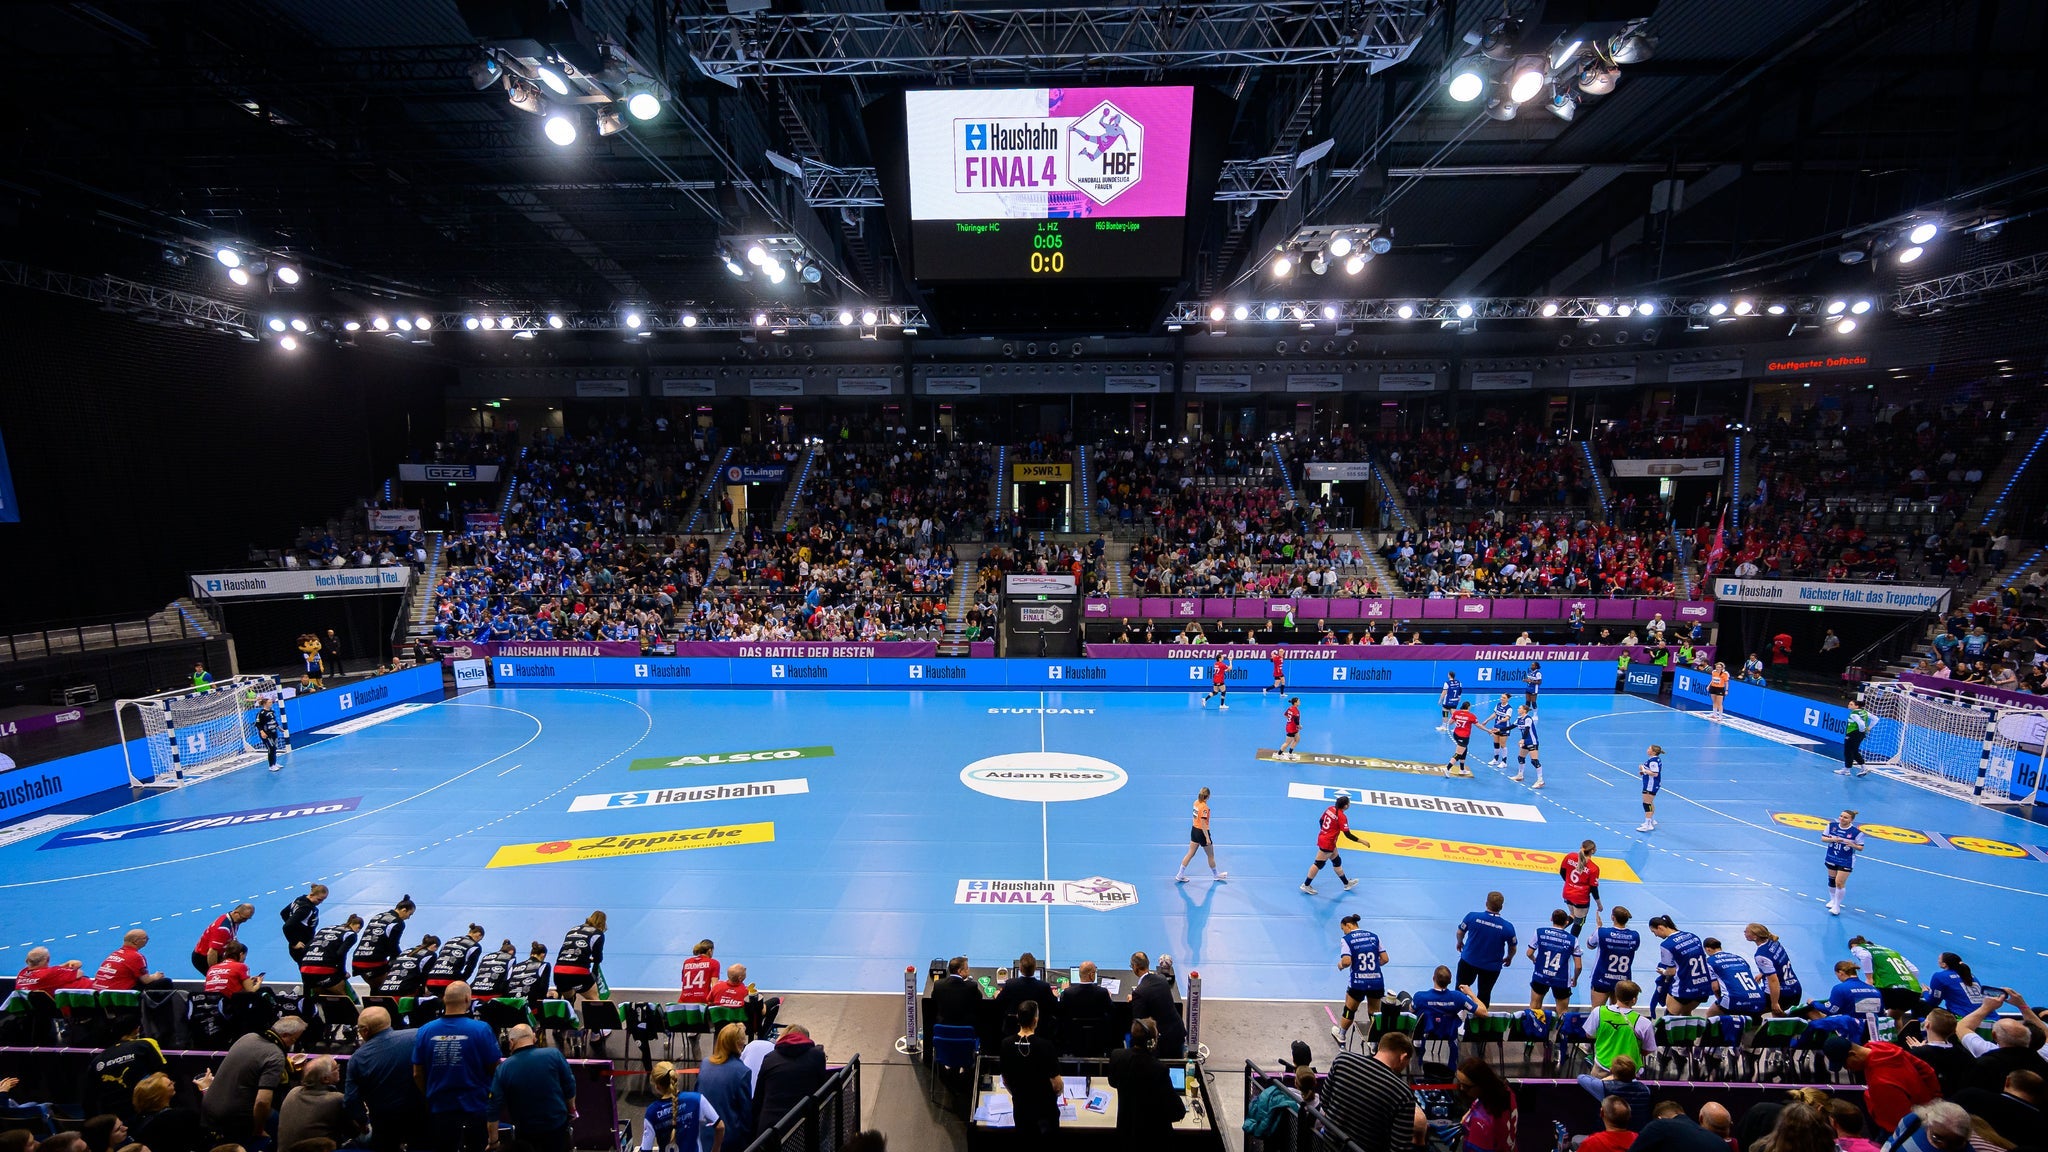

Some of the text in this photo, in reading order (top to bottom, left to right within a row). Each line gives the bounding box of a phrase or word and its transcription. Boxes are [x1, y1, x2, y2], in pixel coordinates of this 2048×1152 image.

[991, 122, 1058, 151] Haushahn
[1102, 152, 1137, 175] HBF
[956, 223, 1000, 234] Thüringer HC
[1037, 222, 1059, 231] 1. HZ
[1033, 234, 1063, 249] 0:05
[1030, 251, 1064, 273] 0:0
[1768, 358, 1824, 371] Stuttgarter
[428, 468, 474, 478] GEZE
[223, 578, 267, 591] Haushahn
[315, 574, 336, 587] Hoch
[337, 573, 364, 586] Hinaus
[364, 574, 381, 585] zum
[1738, 584, 1783, 598] Haushahn
[1800, 586, 1841, 601] Nächster
[1866, 590, 1883, 604] das
[499, 646, 558, 657] HAUSHAHN
[739, 646, 874, 657] DAS BATTLE DER BESTEN
[1475, 650, 1544, 660] HAUSHAHN
[457, 666, 485, 679] hella
[516, 663, 555, 677] Haushahn
[651, 664, 691, 678] Haushahn
[788, 664, 828, 678] Haushahn
[925, 665, 966, 679] Haushahn
[1065, 665, 1106, 680] Haushahn
[1350, 666, 1392, 681] Haushahn
[1627, 672, 1658, 685] hella
[354, 684, 388, 706] Haushahn
[987, 707, 1096, 715] STUTTGART
[0, 721, 18, 738] L4
[664, 749, 801, 768] ALSCO
[985, 771, 1104, 779] Adam Riese
[0, 773, 63, 809] aushahn
[655, 782, 776, 804] Haushahn
[1371, 791, 1504, 817] Haushahn
[577, 828, 743, 851] Lippische
[1440, 842, 1557, 864] LOTTO
[1570, 869, 1580, 884] 6
[991, 881, 1055, 891] Haushahn
[1099, 892, 1131, 901] HBF
[1357, 952, 1376, 971] 33
[1544, 950, 1562, 971] 14
[1607, 954, 1630, 973] 28
[1689, 955, 1707, 977] 21
[1887, 957, 1910, 975] 16
[683, 970, 706, 989] 14
[1734, 972, 1757, 991] 15
[907, 1005, 915, 1038] HAUSHAHN
[1190, 1012, 1198, 1045] HAUSHAHN
